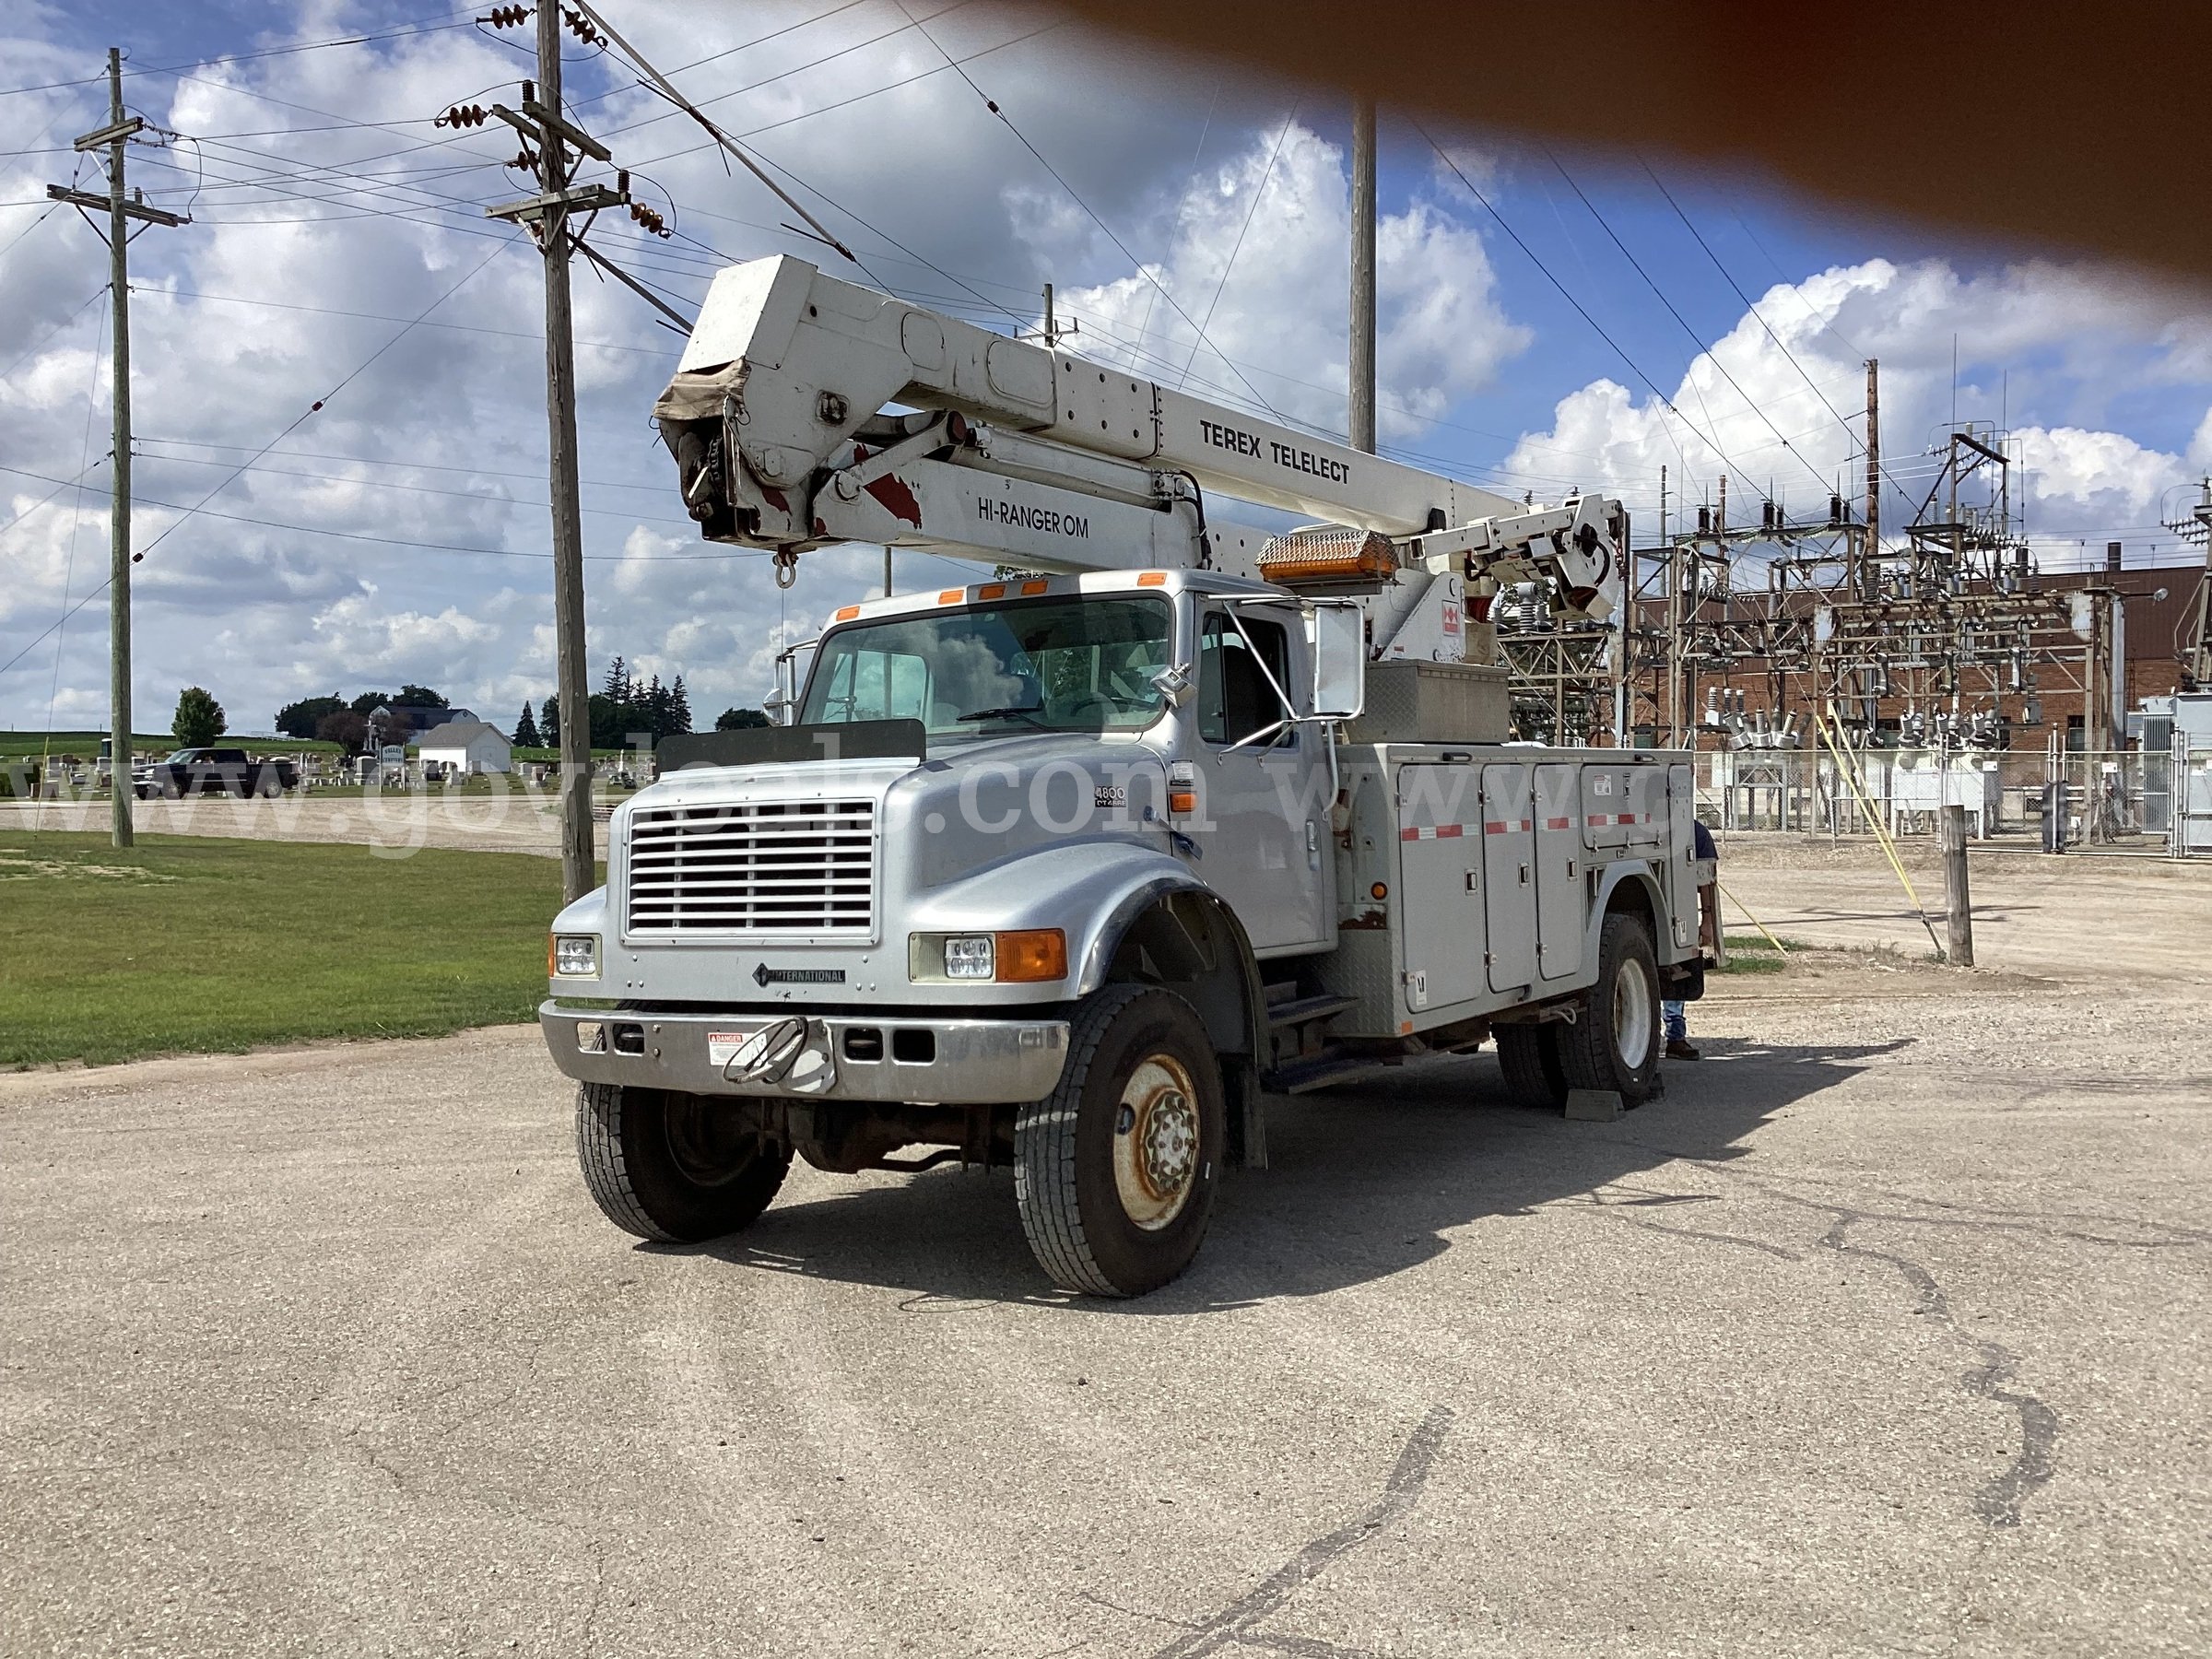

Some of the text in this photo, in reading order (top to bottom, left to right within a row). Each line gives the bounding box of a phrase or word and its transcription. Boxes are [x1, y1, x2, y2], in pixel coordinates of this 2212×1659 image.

[1200, 419, 1350, 485] TEREX TELELECT
[978, 497, 1088, 538] HI-RANGER OM
[1095, 787, 1125, 799] 4800
